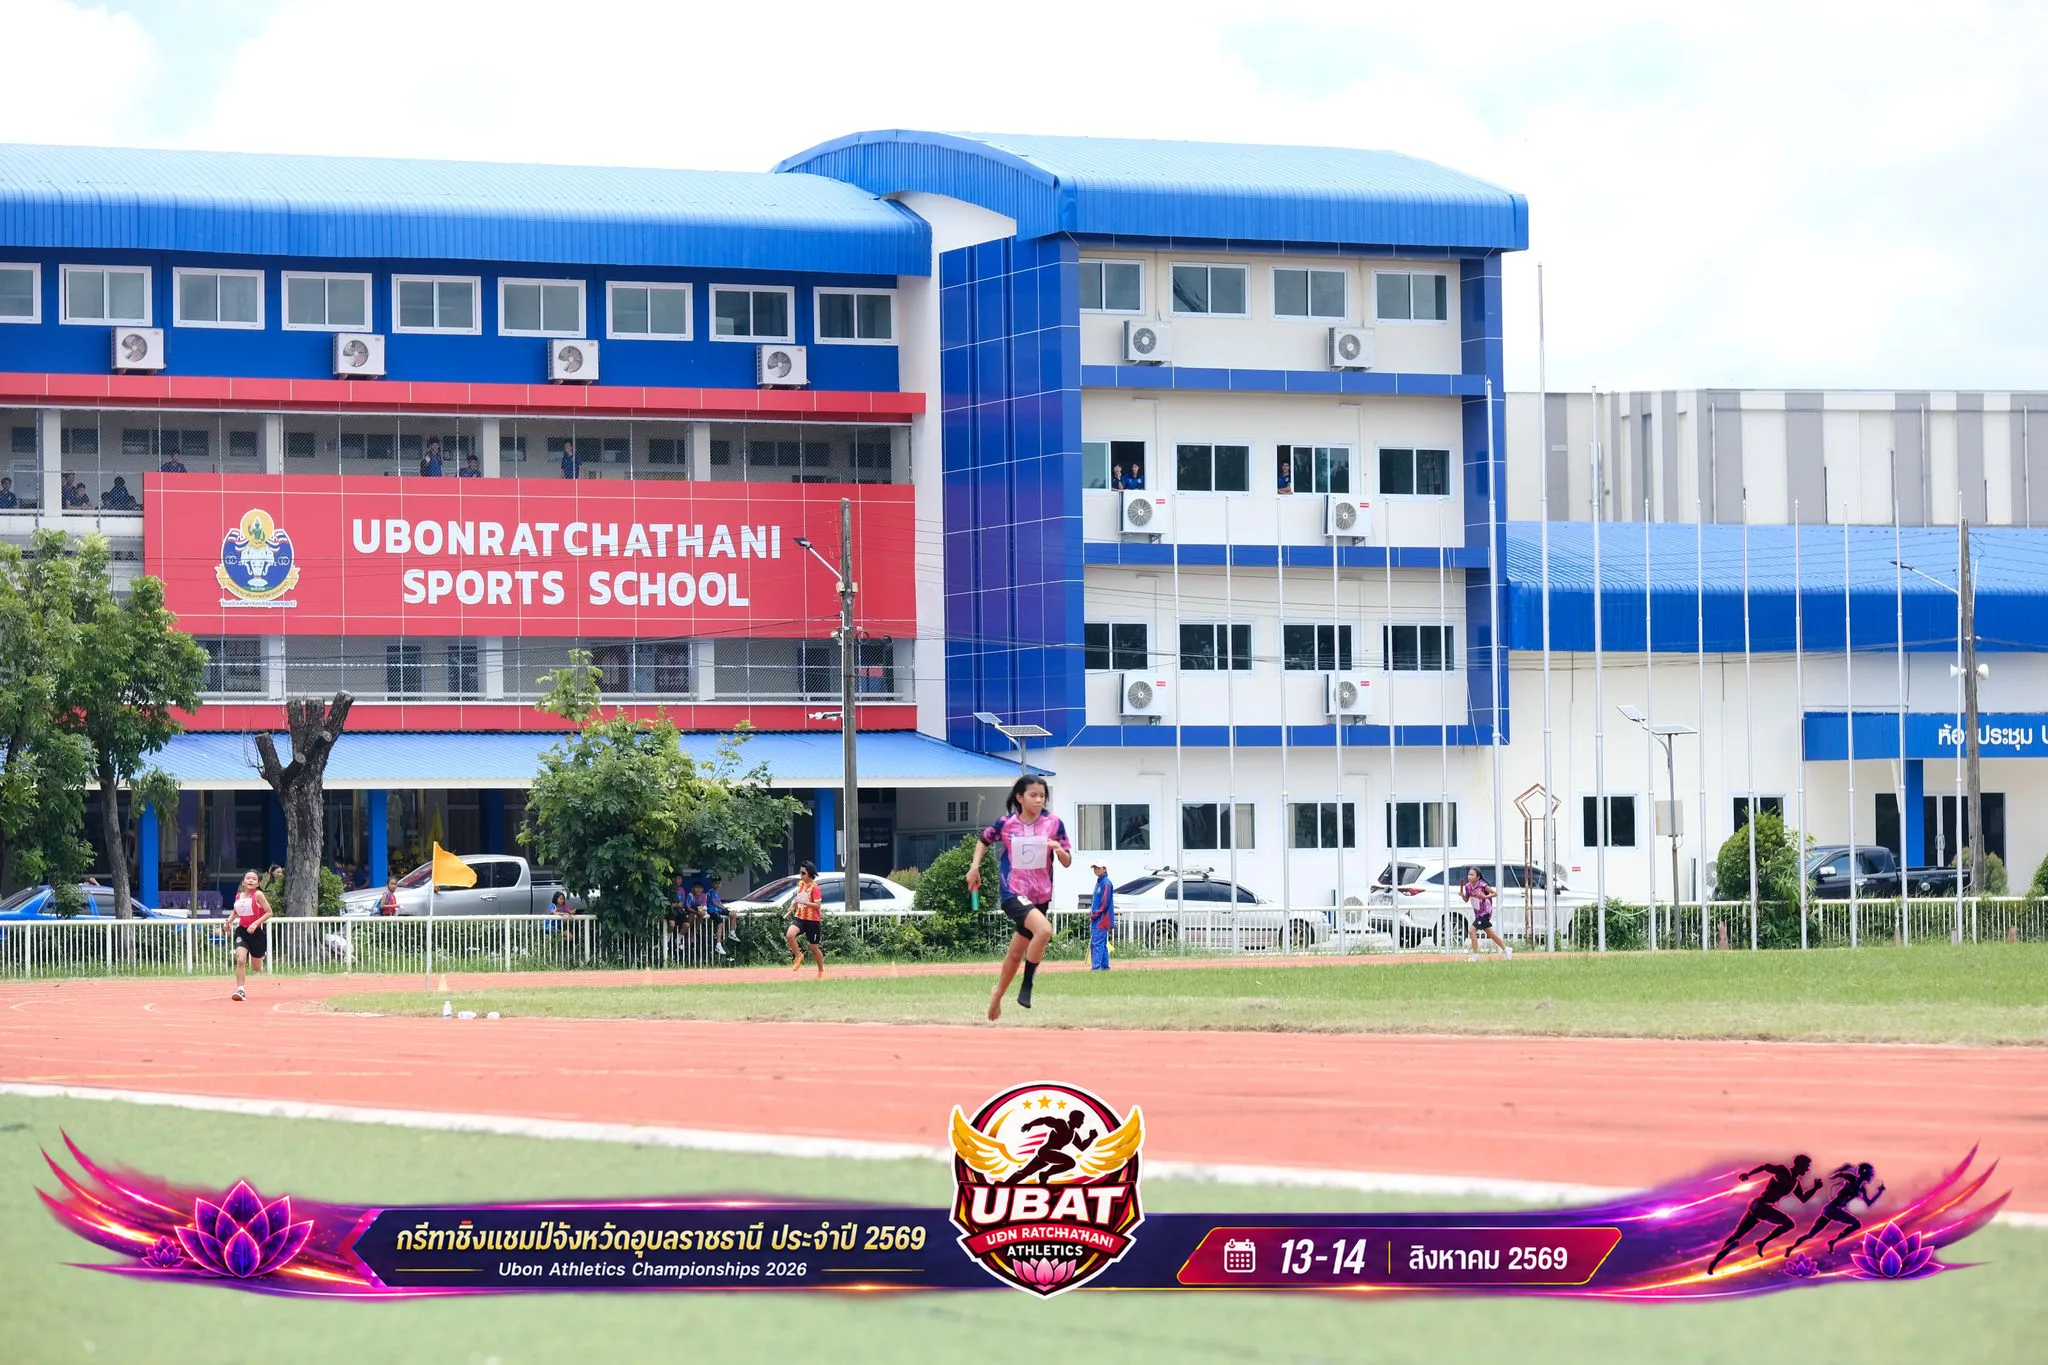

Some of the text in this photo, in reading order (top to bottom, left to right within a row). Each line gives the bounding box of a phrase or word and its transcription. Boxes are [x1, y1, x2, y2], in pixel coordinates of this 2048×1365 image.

[352, 519, 781, 559] UBONRATCHATHANI
[403, 569, 749, 607] SPORTS SCHOOL
[1020, 843, 1036, 866] 5
